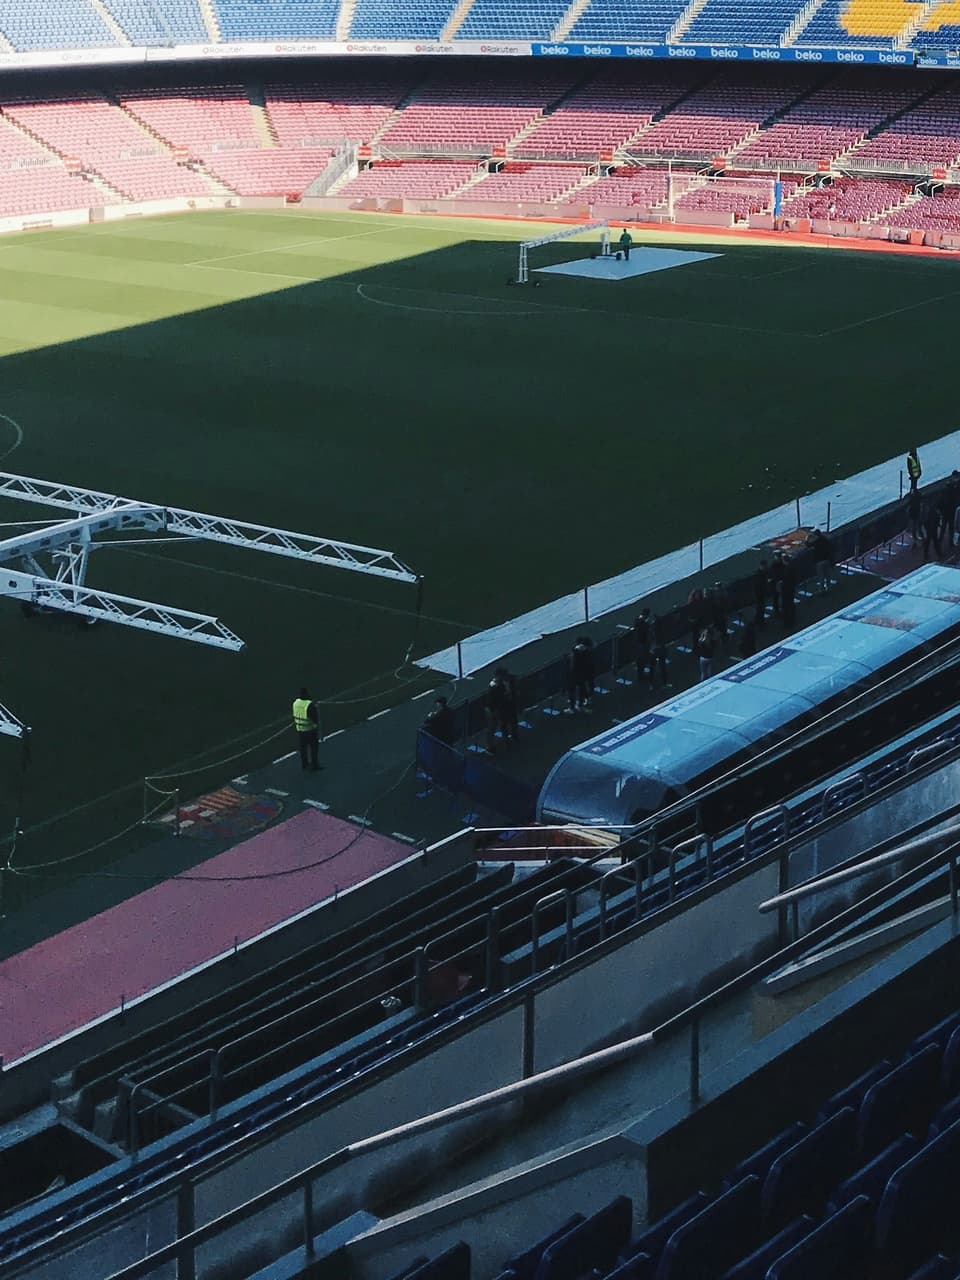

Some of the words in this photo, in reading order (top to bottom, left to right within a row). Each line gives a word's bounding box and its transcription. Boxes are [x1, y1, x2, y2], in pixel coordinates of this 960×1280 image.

[282, 44, 317, 52] Rakuten
[353, 44, 387, 52] Rakuten
[422, 45, 454, 53] Rakuten
[487, 45, 518, 54] Rakuten
[540, 45, 569, 55] beko
[583, 46, 611, 55] beko
[626, 46, 654, 56] beko
[668, 47, 696, 57] beko
[711, 47, 738, 58] beko
[753, 48, 780, 59] beko
[794, 50, 822, 61] beko
[836, 51, 864, 62] beko
[879, 52, 906, 63] beko
[920, 57, 938, 65] beko
